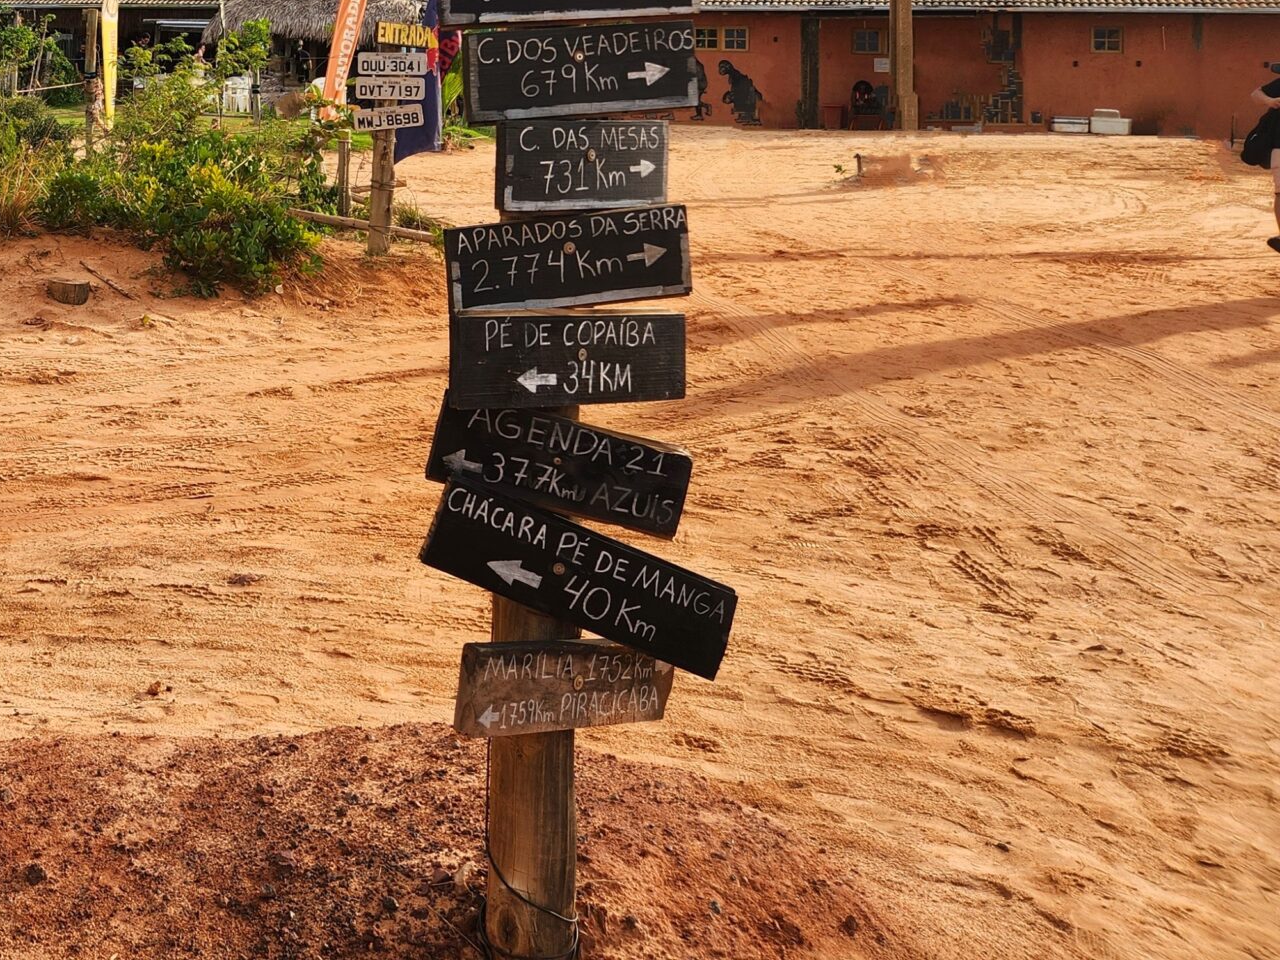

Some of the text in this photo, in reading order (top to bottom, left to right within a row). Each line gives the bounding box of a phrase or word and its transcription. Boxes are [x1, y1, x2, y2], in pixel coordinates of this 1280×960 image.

[378, 22, 431, 48] ENTRADA
[506, 38, 557, 64] DOS
[564, 28, 695, 57] VEADEIROS
[552, 127, 589, 151] DAS
[601, 126, 660, 151] MESAS
[457, 207, 686, 256] APARADOS DA SERRA
[485, 317, 656, 352] PÉ DE COPAÍBA
[467, 408, 668, 477] AGENDA 21
[447, 487, 726, 624] CHÁCARA PÉ DE MANGA
[559, 686, 659, 721] PIRACICABA
